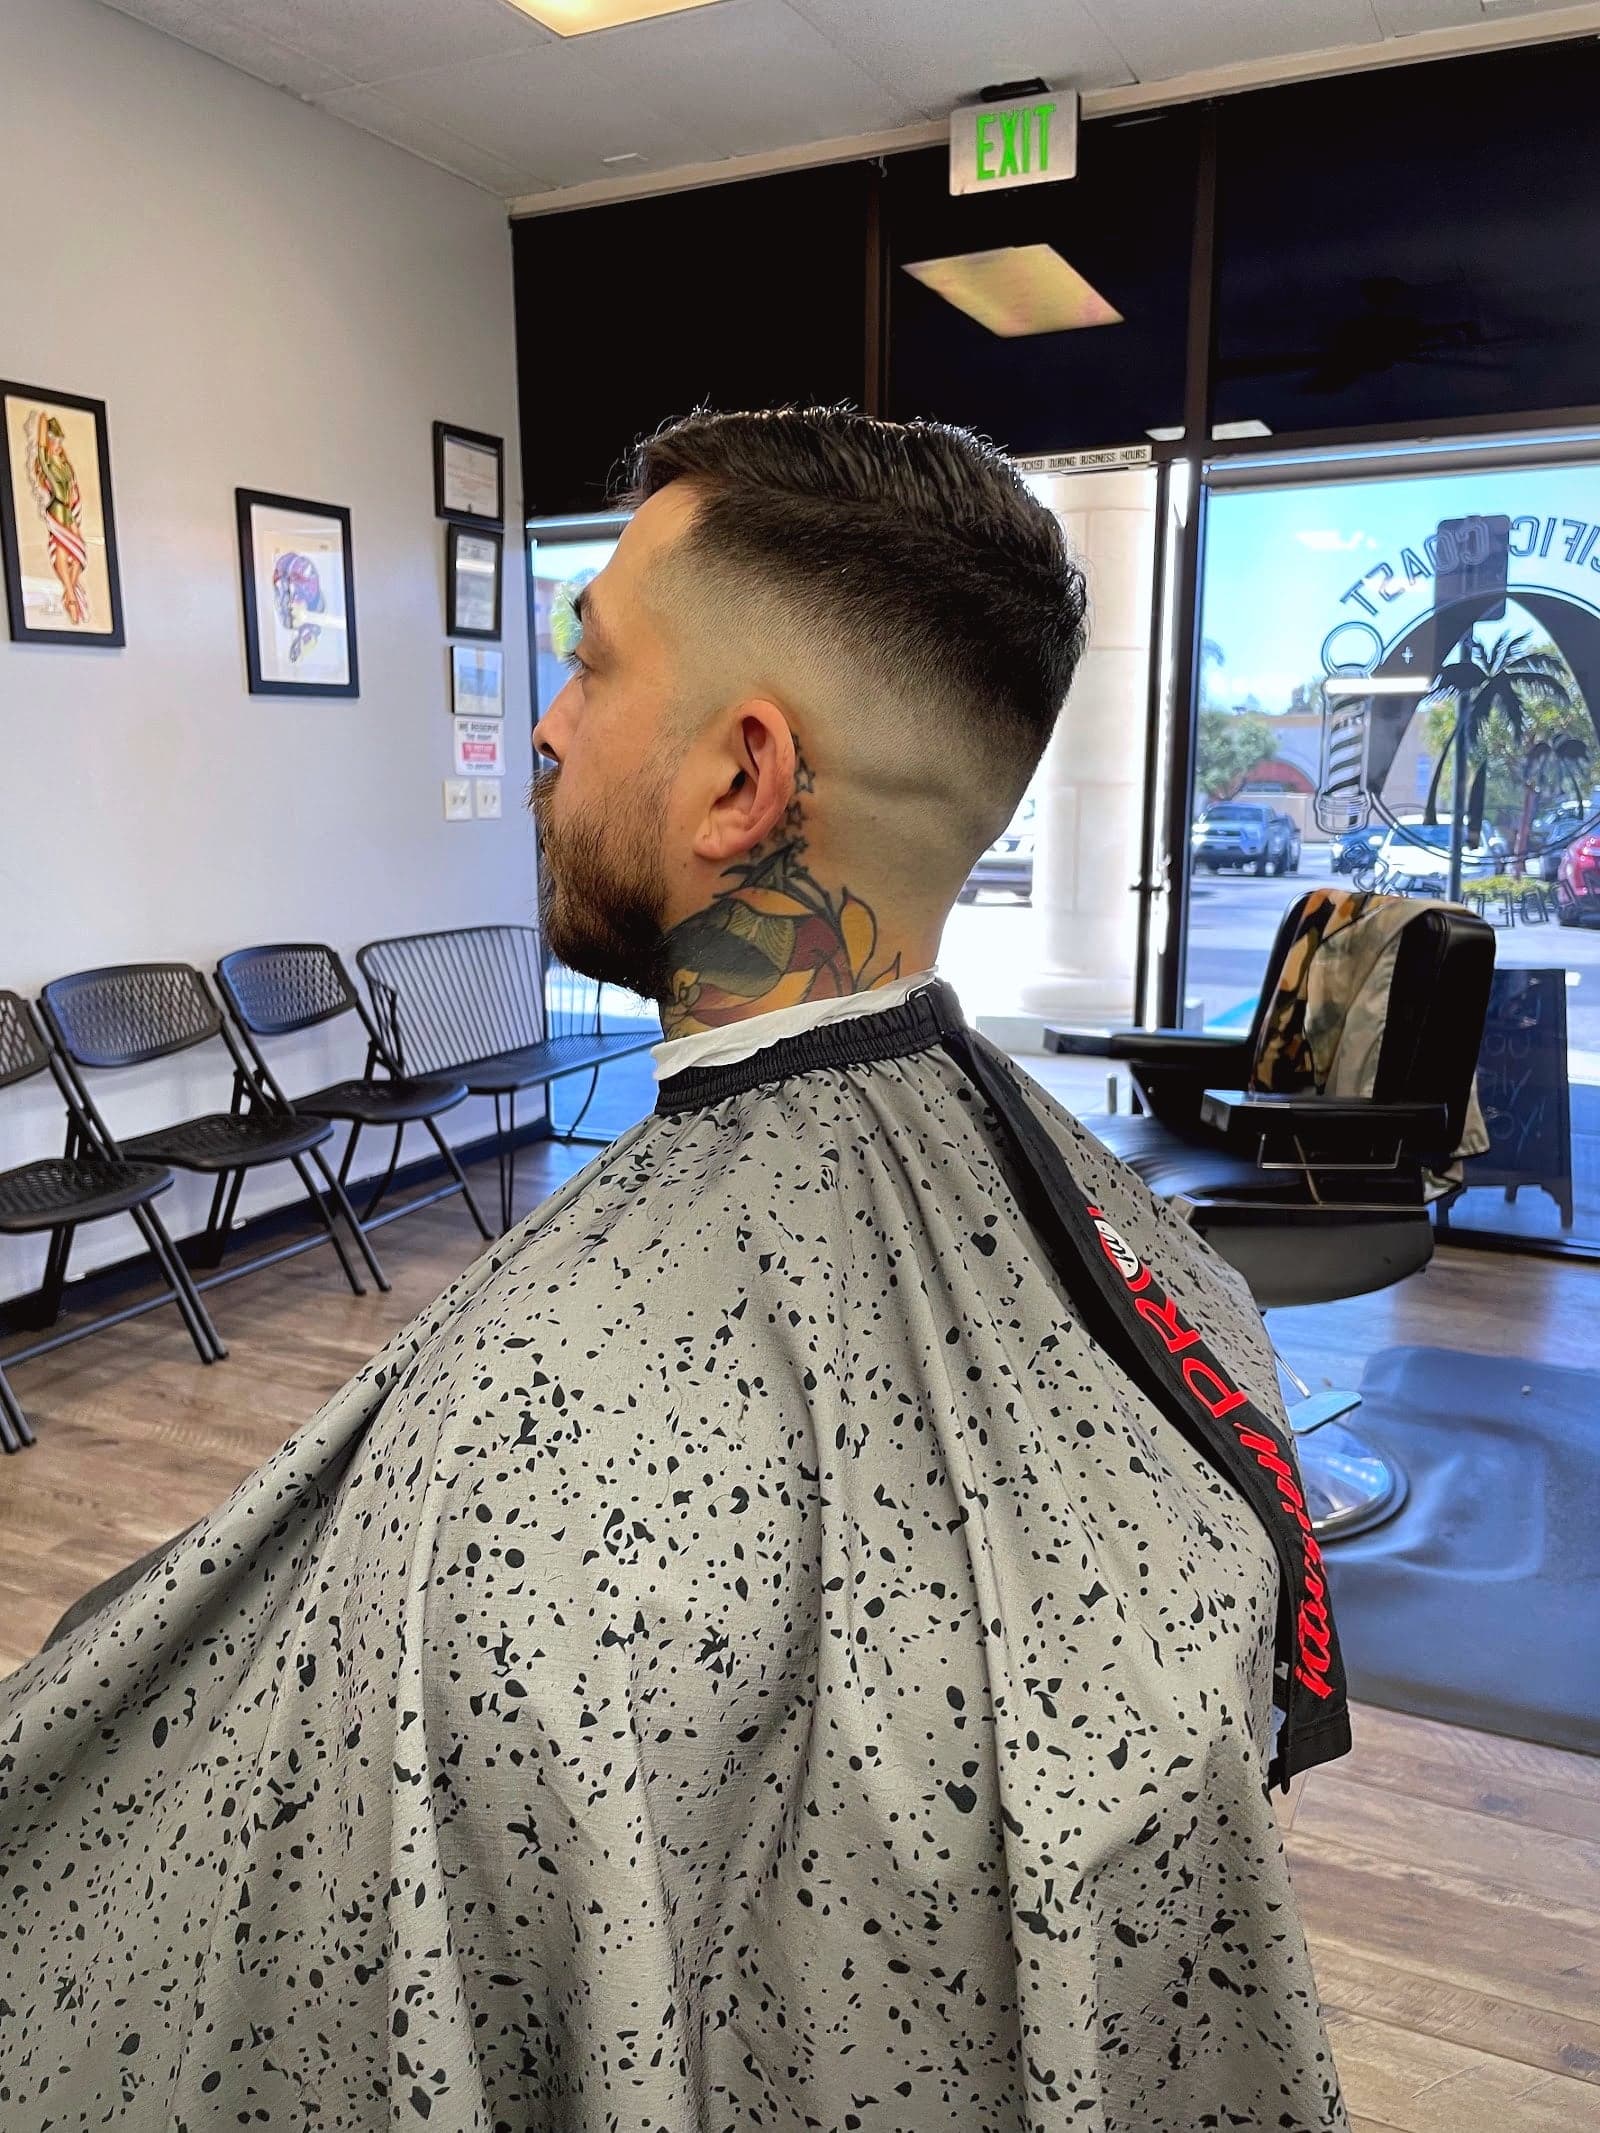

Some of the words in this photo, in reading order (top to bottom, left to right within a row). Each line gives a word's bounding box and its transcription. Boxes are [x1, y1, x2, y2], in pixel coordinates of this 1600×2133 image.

[976, 103, 1056, 180] EXIT
[1079, 452, 1117, 466] BUSINESS
[1119, 448, 1147, 460] HOURS
